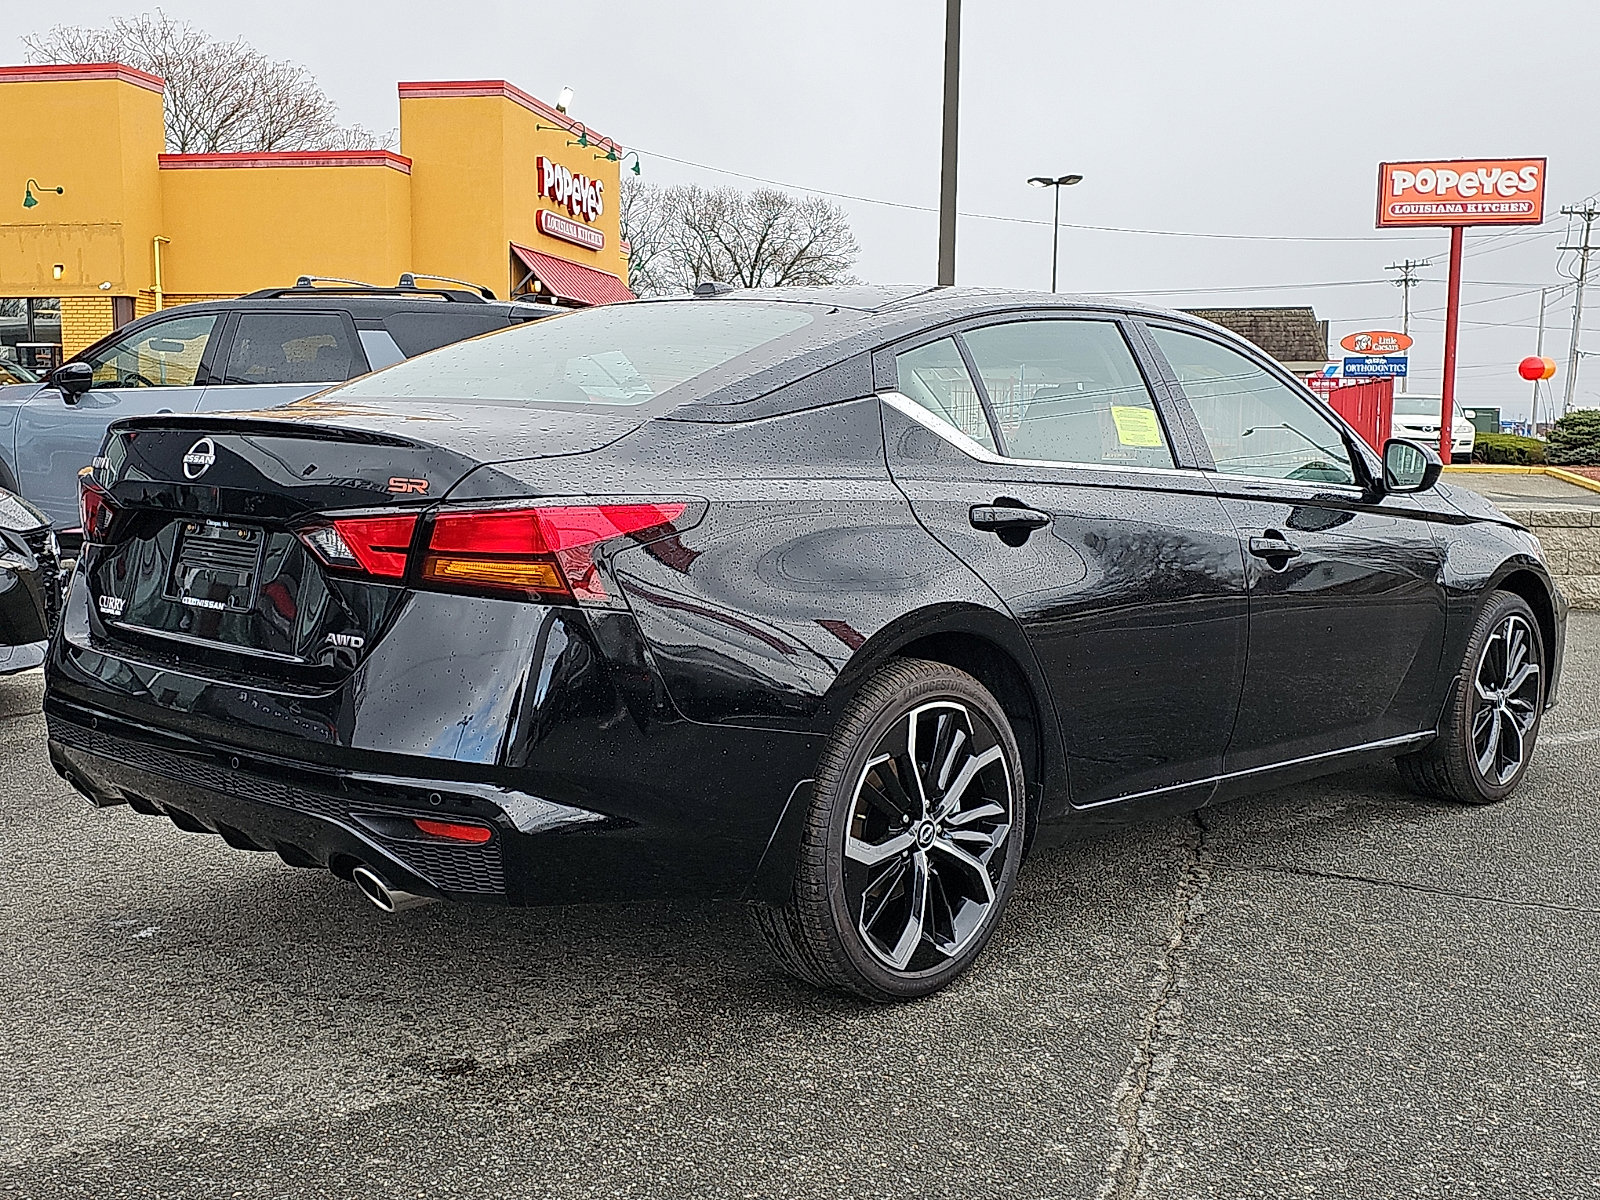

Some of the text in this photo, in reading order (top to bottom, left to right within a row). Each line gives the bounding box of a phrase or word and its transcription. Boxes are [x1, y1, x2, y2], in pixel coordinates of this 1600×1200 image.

[1394, 202, 1530, 214] LOUISIANA KITCHEN
[546, 215, 579, 239] LOUISIANA
[1345, 363, 1406, 373] ORTHODONTICS
[387, 477, 430, 495] SR
[99, 595, 126, 611] CURRY
[325, 632, 365, 648] AWD
